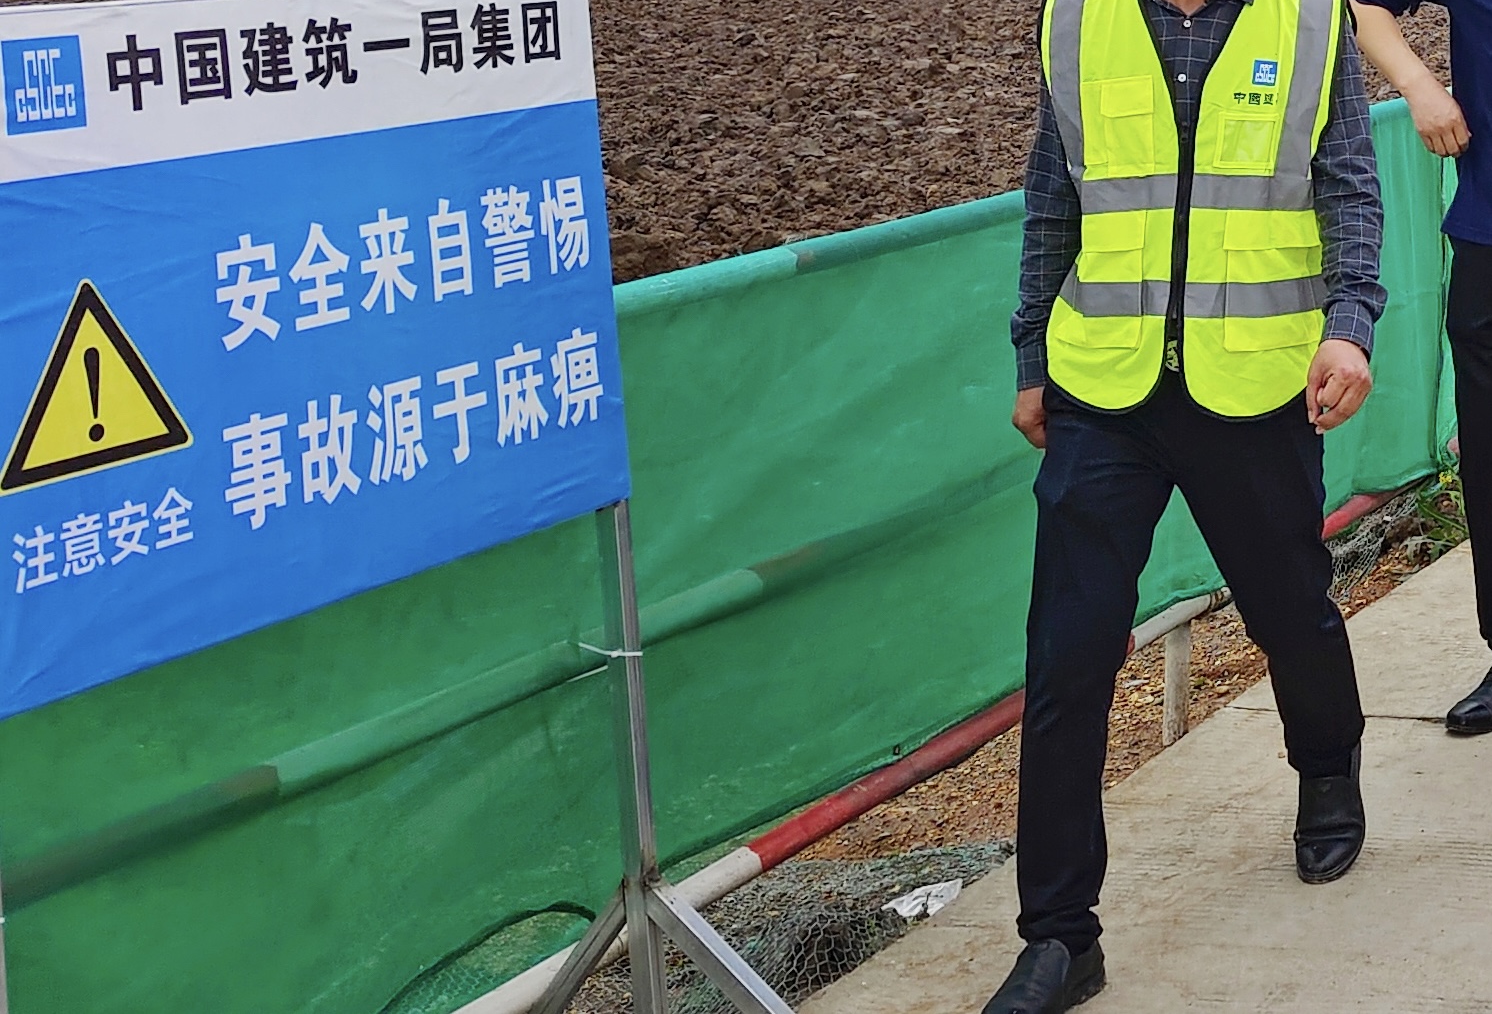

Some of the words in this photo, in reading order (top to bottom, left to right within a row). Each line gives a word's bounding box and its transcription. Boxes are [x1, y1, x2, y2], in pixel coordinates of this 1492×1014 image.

[106, 0, 562, 112] 中国建筑一局集团
[215, 176, 590, 352] 安全来自警惕
[222, 327, 605, 531] 事故源于麻痹
[12, 487, 195, 593] 注意安全
